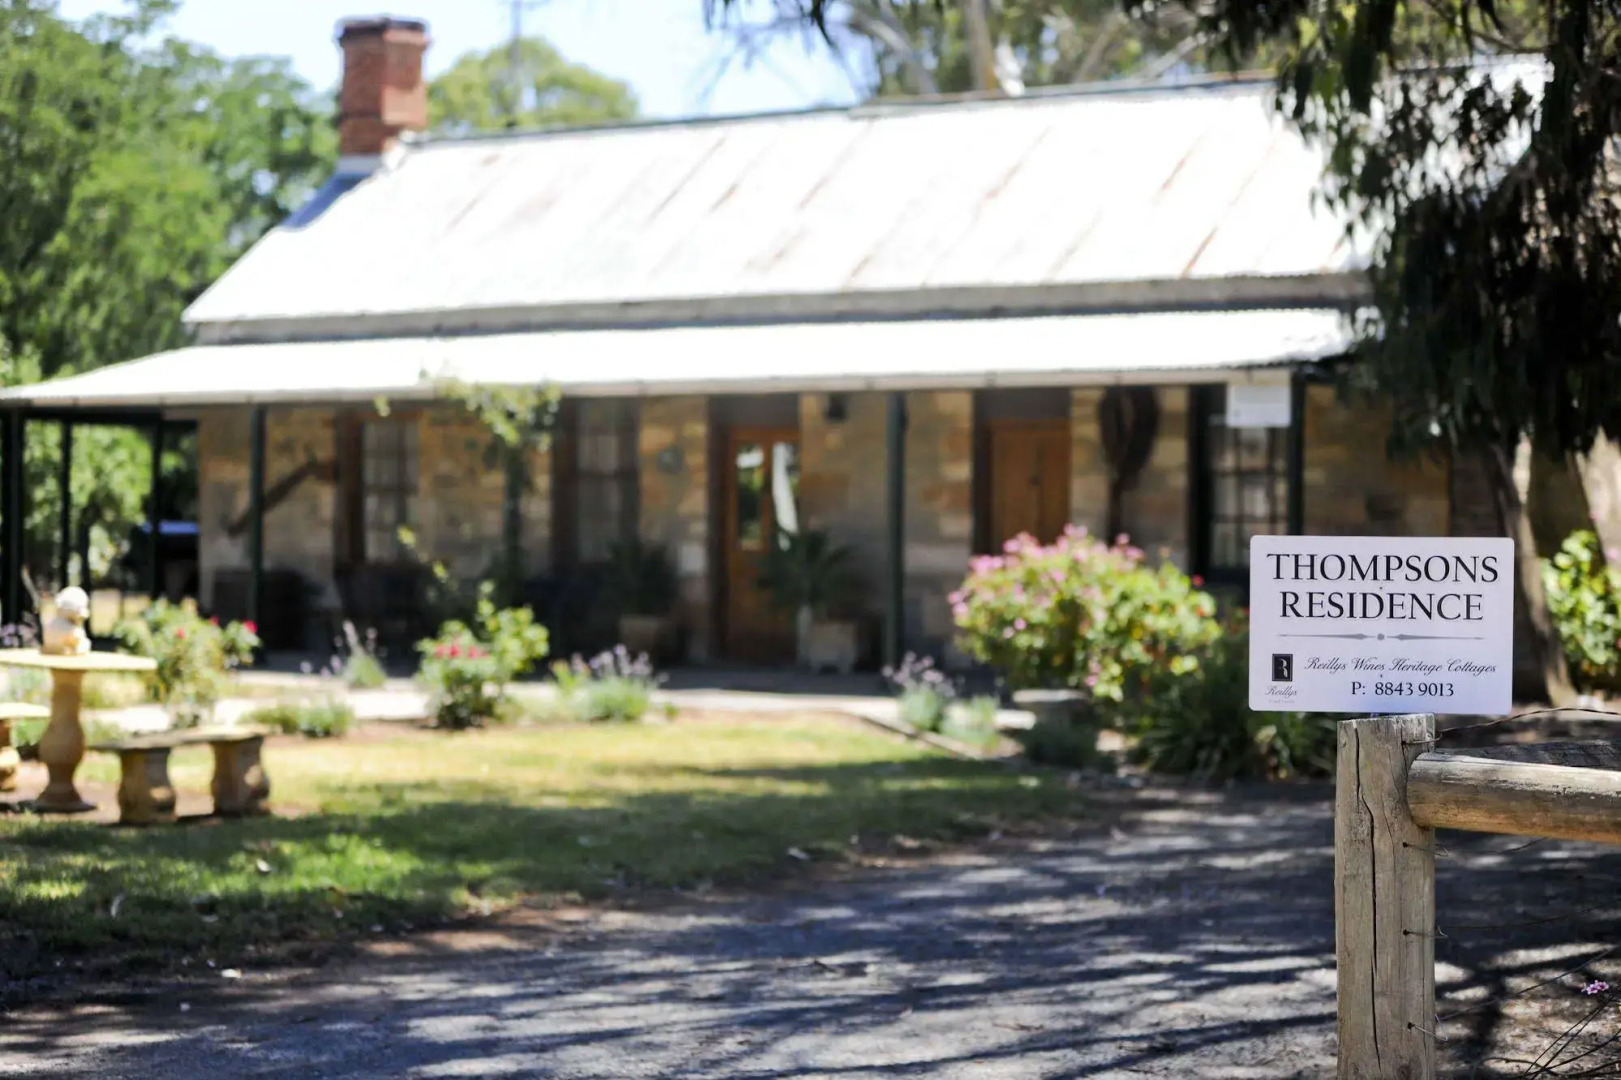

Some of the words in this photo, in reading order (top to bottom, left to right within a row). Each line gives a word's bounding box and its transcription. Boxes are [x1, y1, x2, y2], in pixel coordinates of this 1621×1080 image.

[1266, 553, 1499, 583] THOMPSONS
[1279, 591, 1484, 621] RESIDENCE
[1304, 657, 1348, 674] Reillys
[1351, 656, 1385, 671] Wines
[1389, 657, 1443, 676] Heritage
[1447, 658, 1497, 677] Cottages
[1265, 685, 1298, 699] Reillys
[1351, 681, 1366, 696] P:
[1375, 681, 1414, 696] 8843
[1418, 682, 1454, 697] 9013
